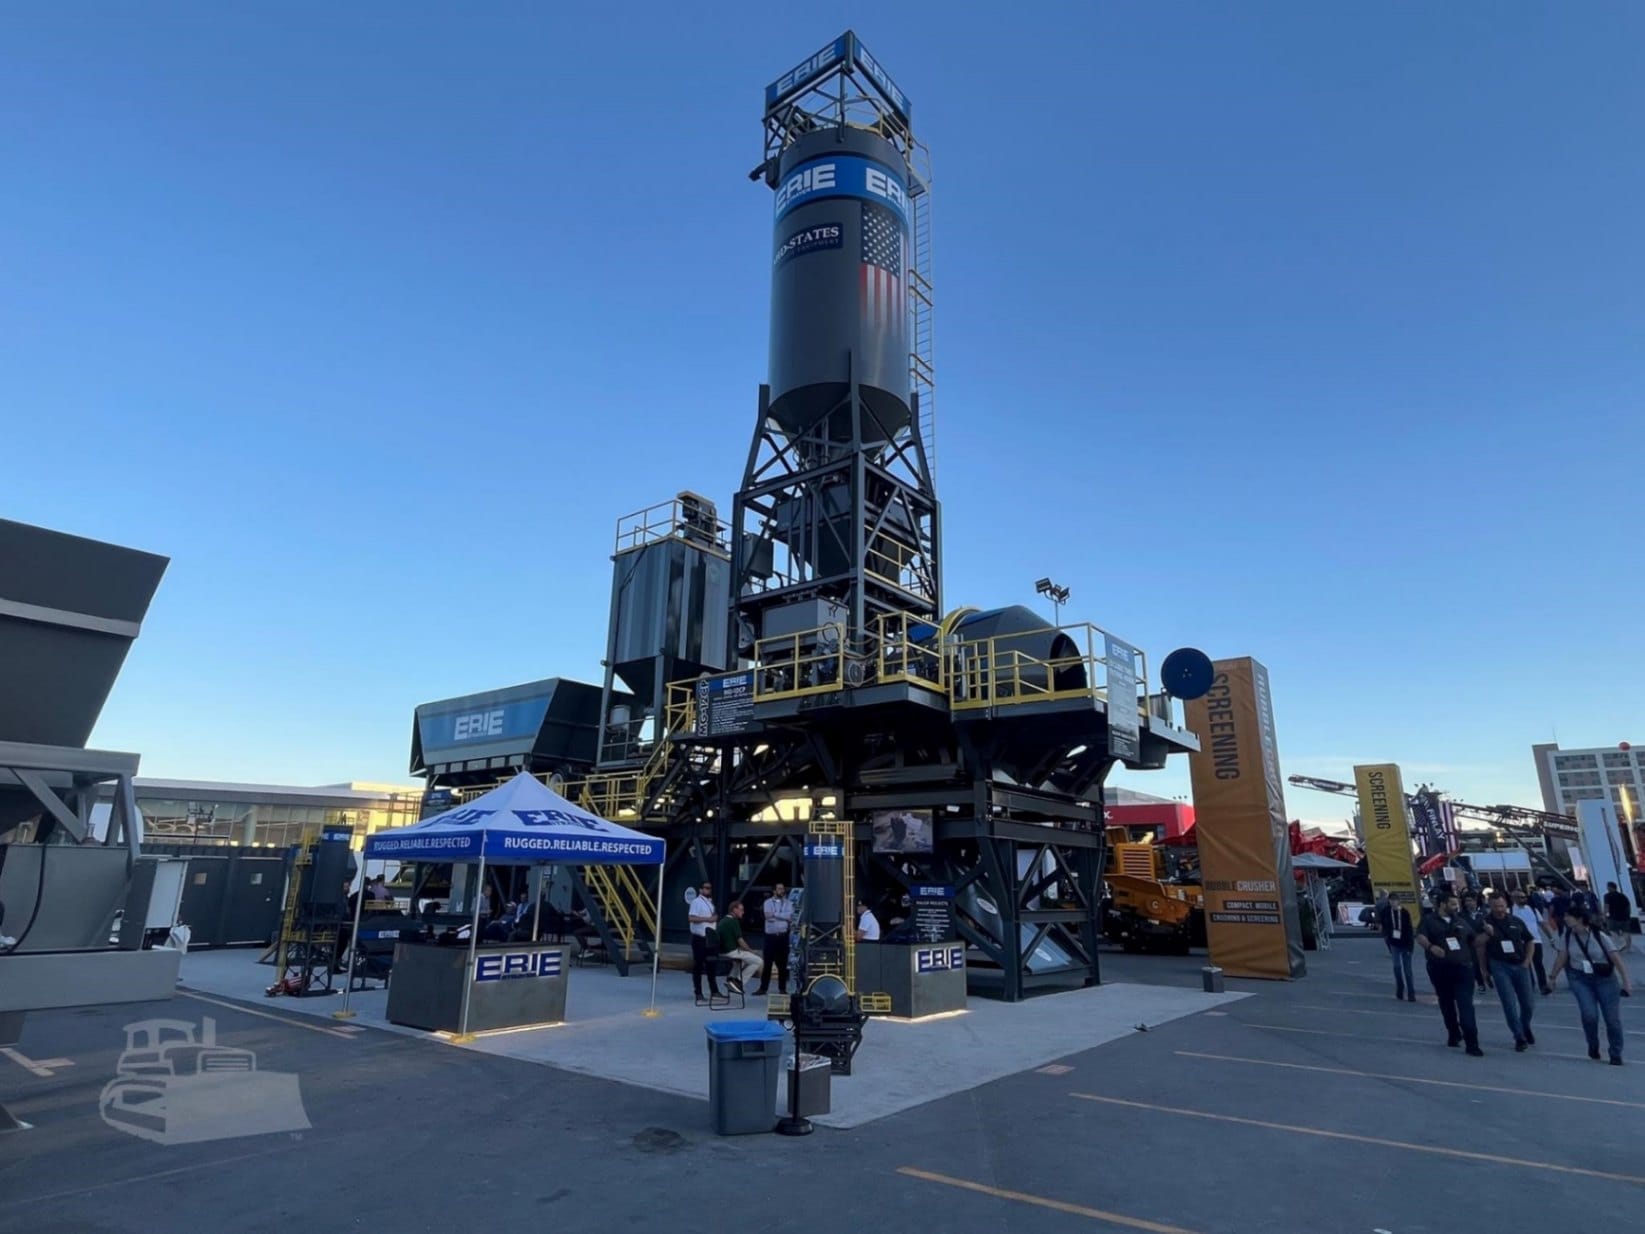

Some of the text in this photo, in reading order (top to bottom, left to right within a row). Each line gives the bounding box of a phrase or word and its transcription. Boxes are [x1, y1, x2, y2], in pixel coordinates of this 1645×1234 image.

[777, 43, 836, 98] ERIE
[860, 47, 904, 111] ERIE
[776, 163, 836, 218] ERIE
[865, 166, 907, 214] ERI
[722, 675, 747, 689] ERIE
[454, 710, 504, 740] ERIE
[1207, 672, 1240, 780] SCREENING
[1368, 771, 1391, 829] SCREENING
[511, 809, 610, 833] ERIE
[504, 837, 652, 855] RUGGED.RELIABLE.RESPECTED
[920, 887, 944, 896] ERIE
[475, 951, 562, 982] ERIE
[916, 947, 963, 974] ERIE
